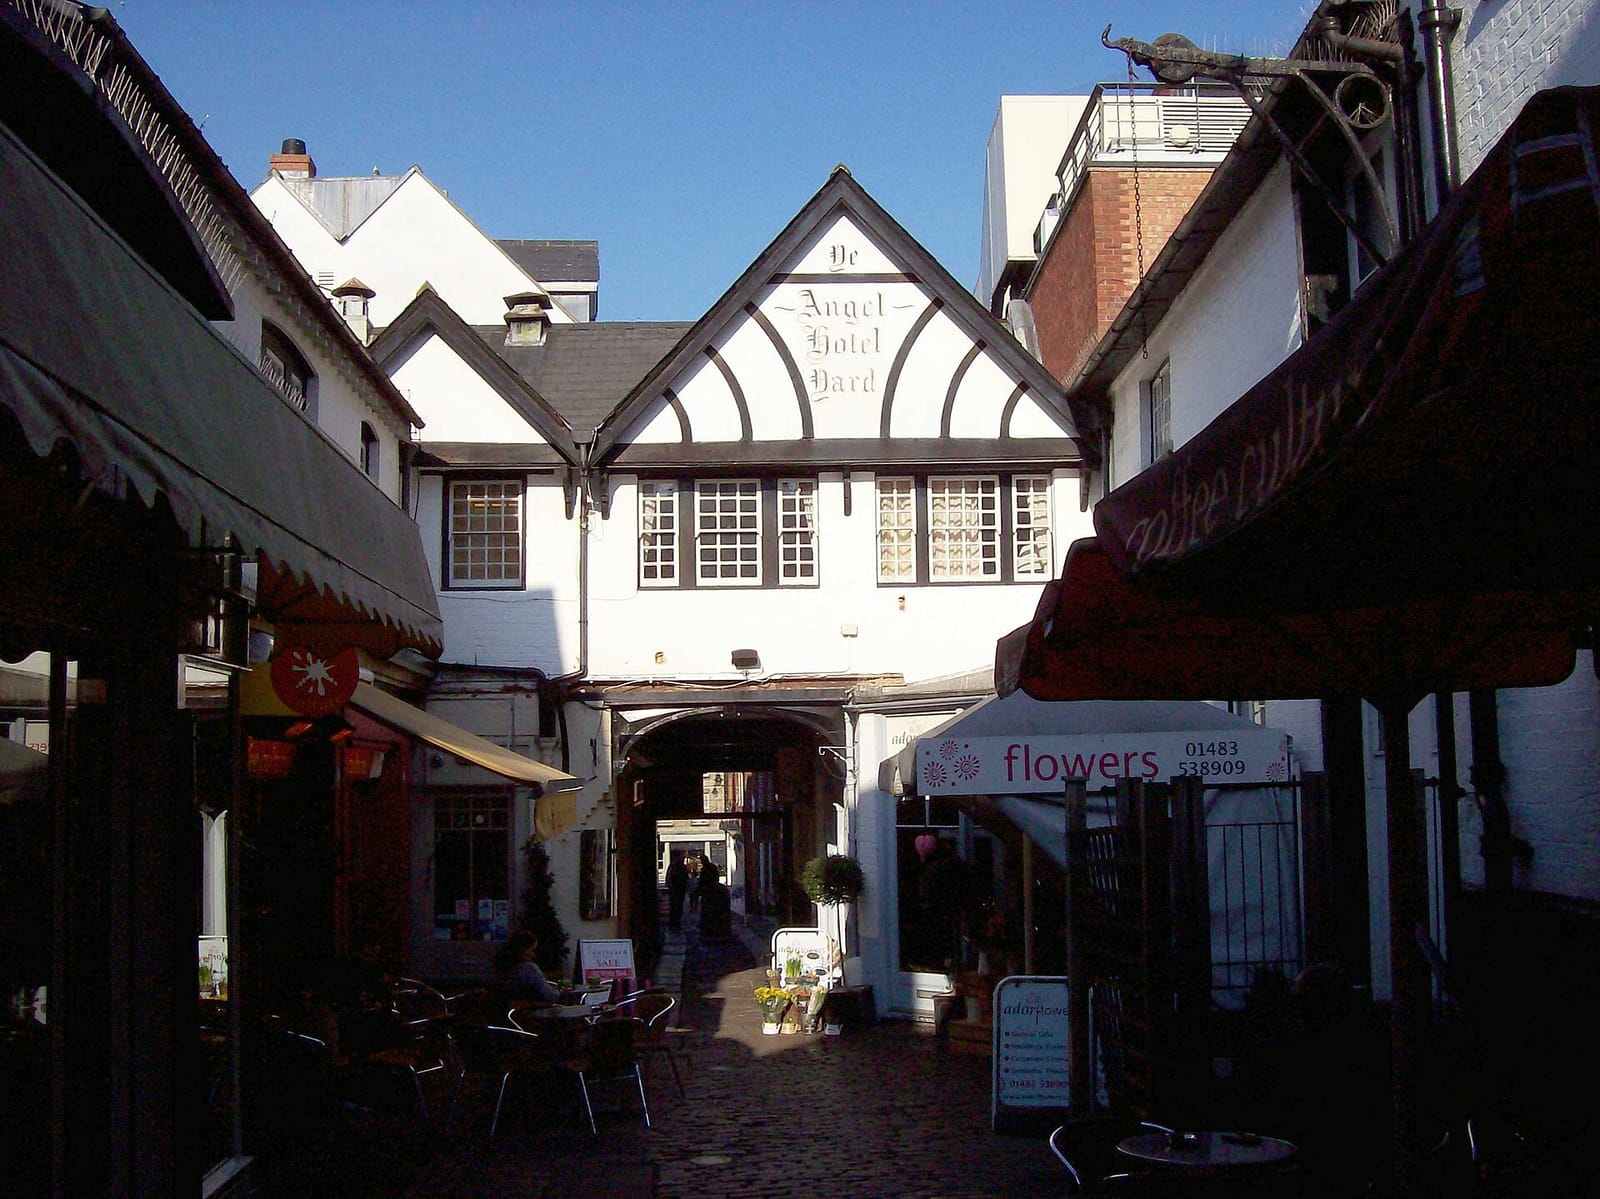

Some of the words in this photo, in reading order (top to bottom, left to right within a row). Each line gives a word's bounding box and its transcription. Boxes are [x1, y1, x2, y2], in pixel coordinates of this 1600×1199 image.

[829, 244, 858, 272] Ye
[797, 289, 886, 324] Angel
[802, 325, 881, 365] Hotel
[810, 368, 876, 402] Yard
[1003, 743, 1159, 782] flowers
[1185, 741, 1239, 757] 01483
[1178, 760, 1246, 777] 538909
